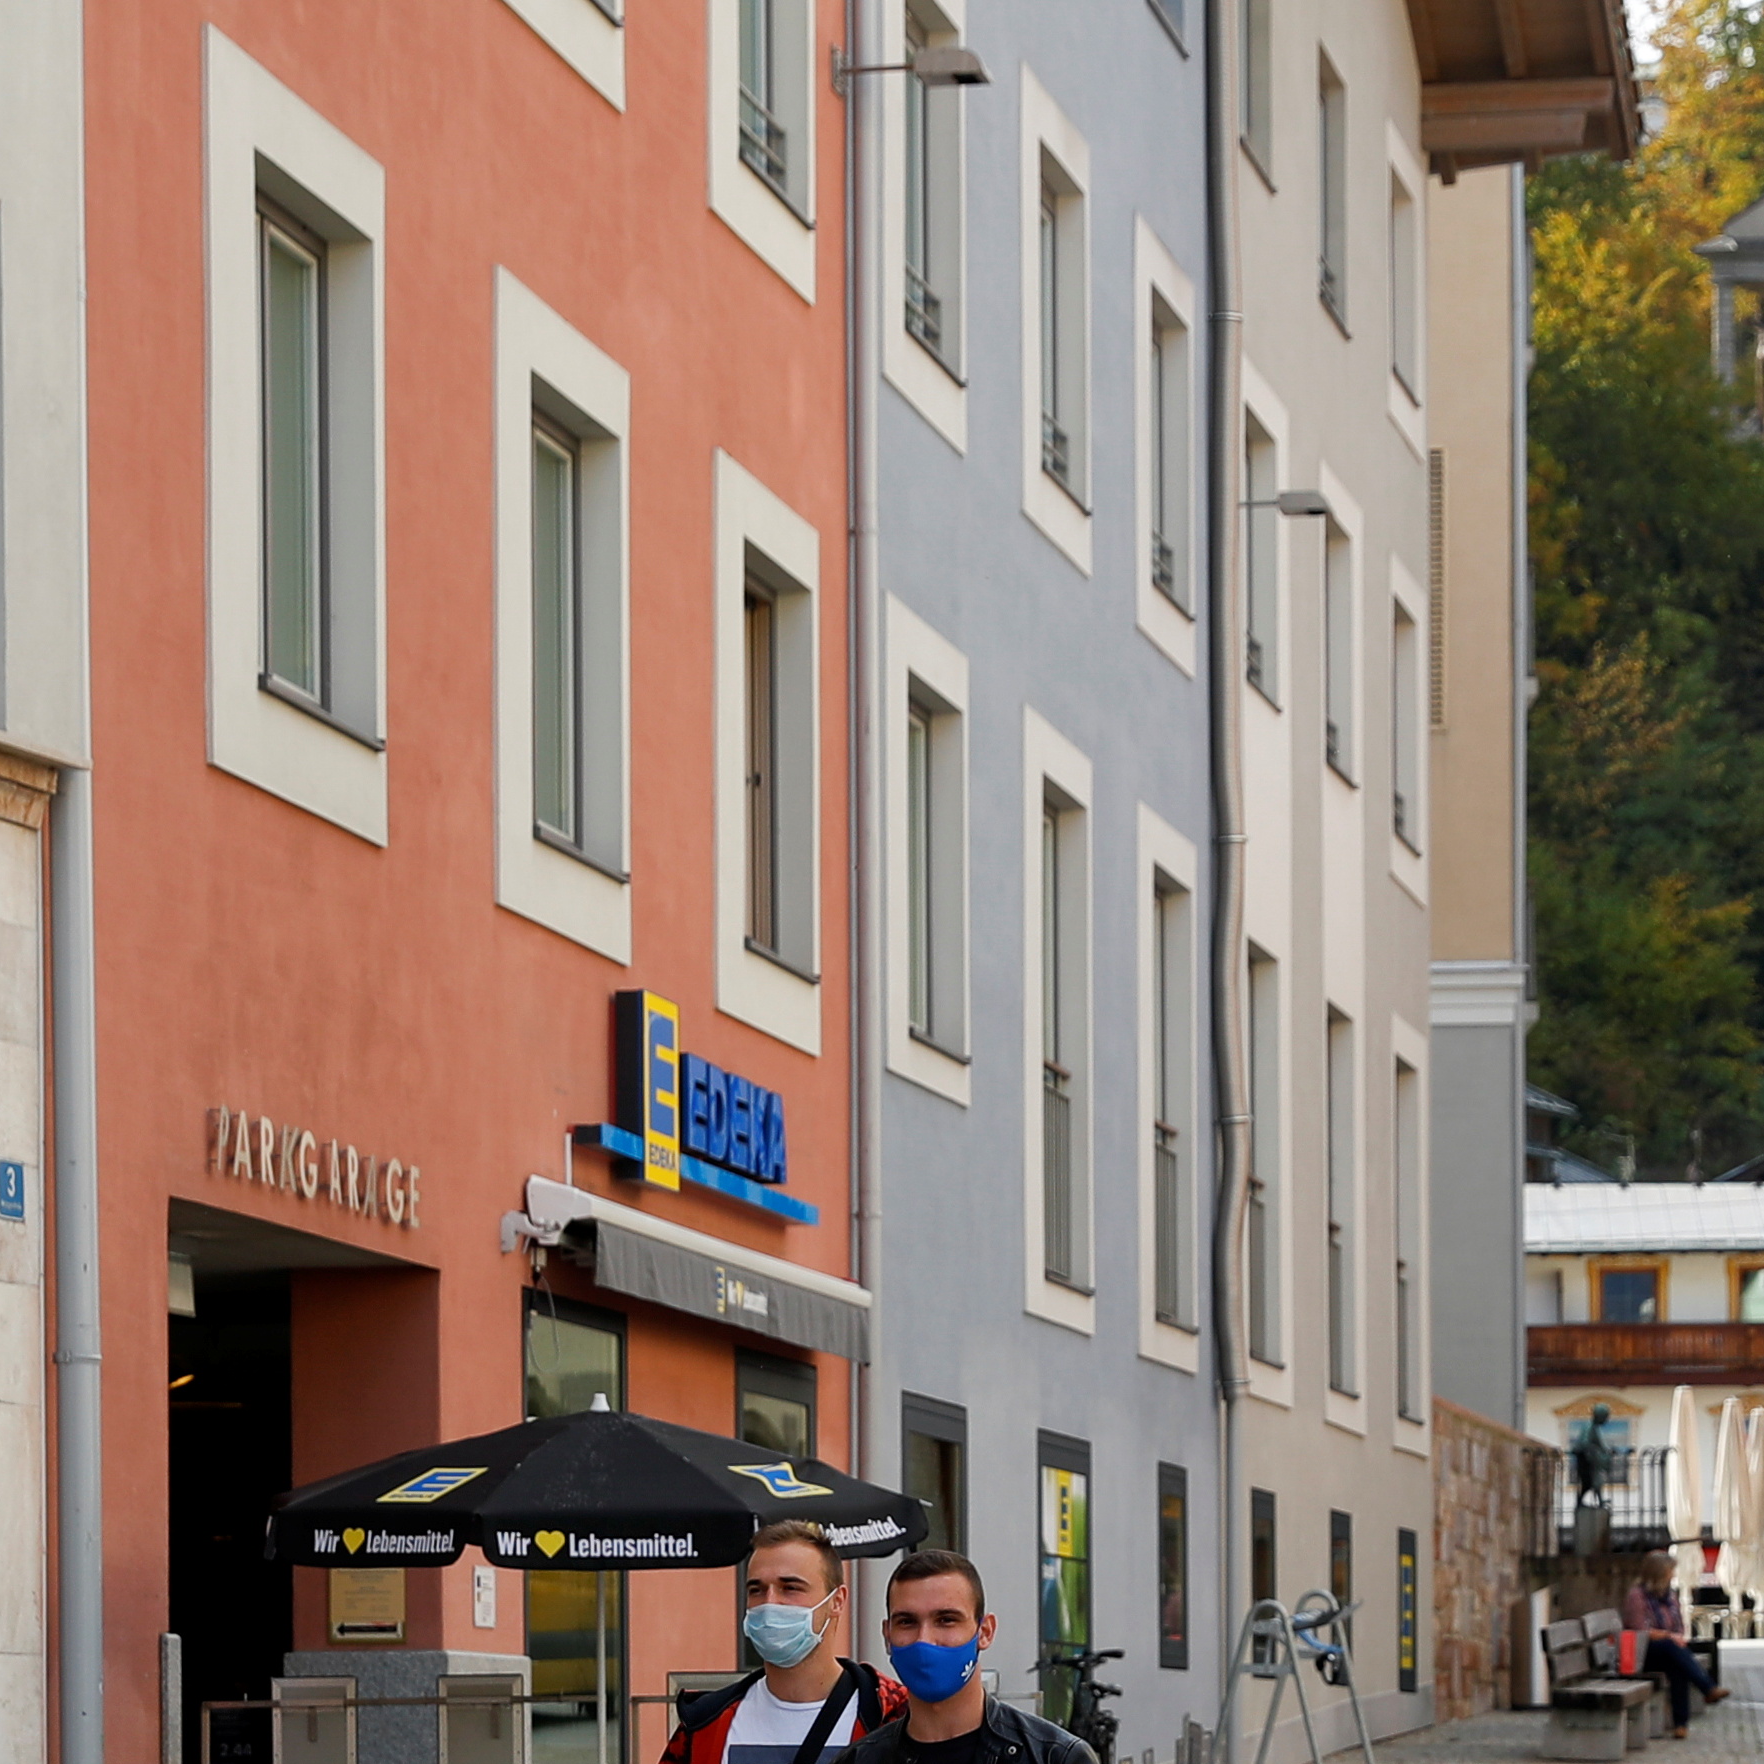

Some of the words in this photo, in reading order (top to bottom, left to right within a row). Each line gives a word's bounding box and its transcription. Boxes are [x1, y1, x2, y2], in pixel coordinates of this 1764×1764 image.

[680, 1051, 789, 1185] EDEKA
[6, 1165, 16, 1198] 3
[314, 1528, 341, 1554] Wir
[366, 1528, 455, 1554] Lebensmittel.
[496, 1530, 532, 1556] Wir
[568, 1532, 699, 1558] Lebensmittel.
